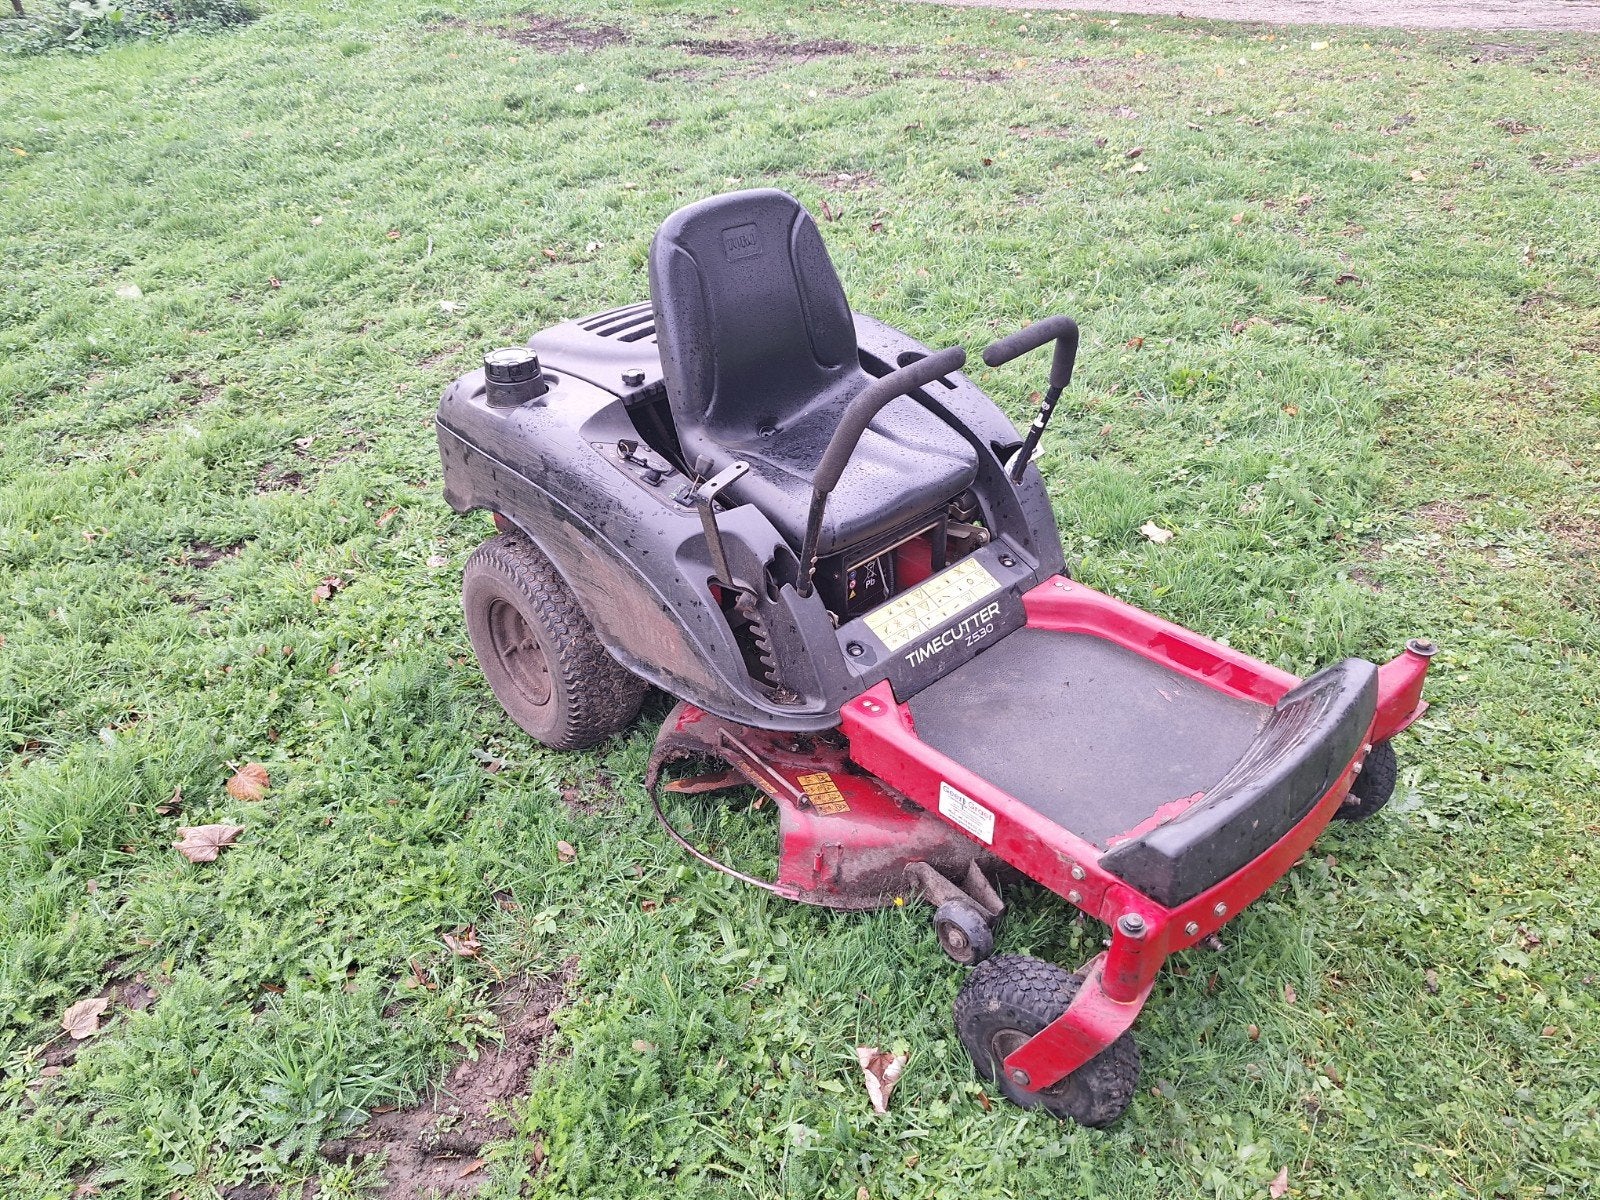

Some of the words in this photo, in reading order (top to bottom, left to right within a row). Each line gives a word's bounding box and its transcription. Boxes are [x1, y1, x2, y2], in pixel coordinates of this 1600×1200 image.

[865, 578, 876, 589] Pb
[905, 602, 1000, 668] TIMECUTTER
[965, 623, 994, 646] Z530
